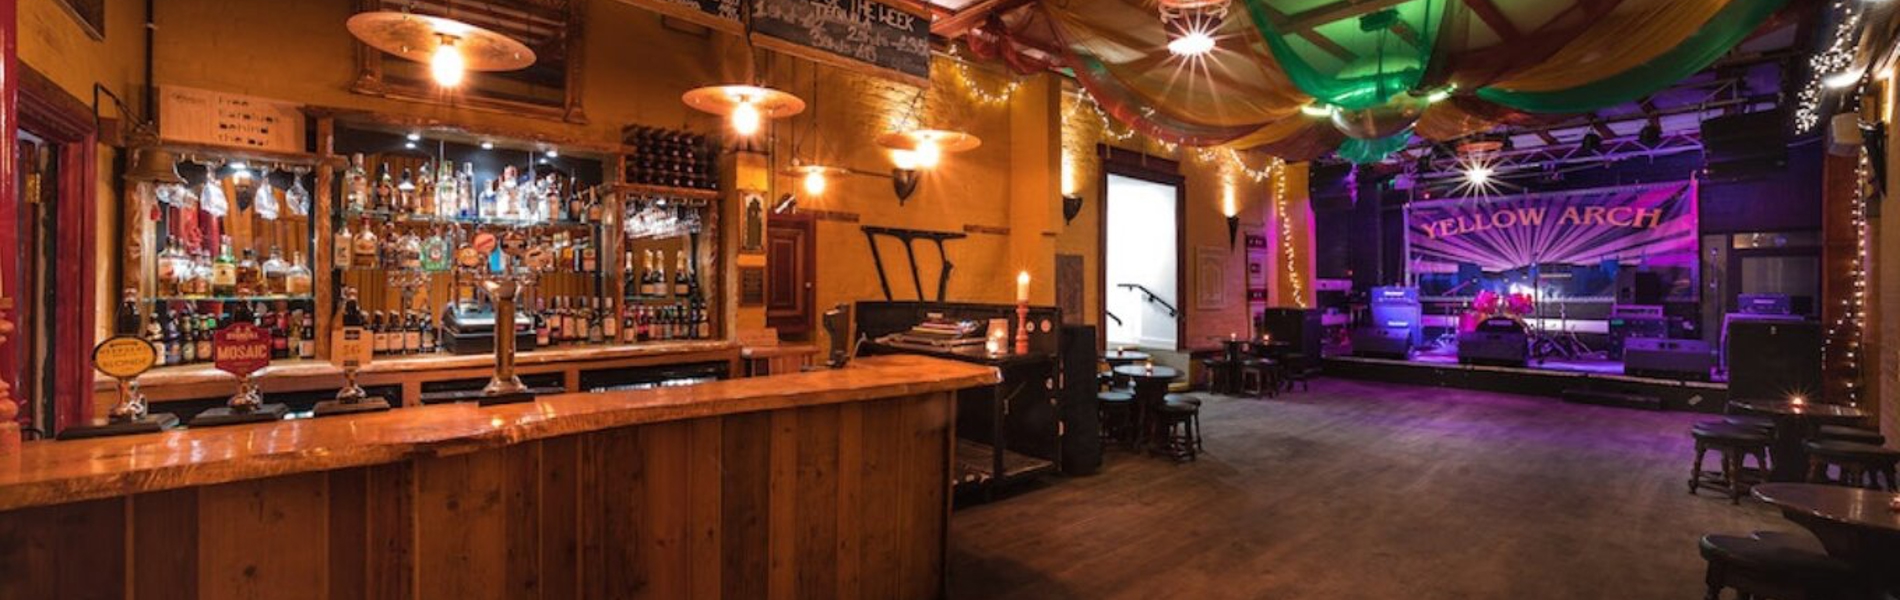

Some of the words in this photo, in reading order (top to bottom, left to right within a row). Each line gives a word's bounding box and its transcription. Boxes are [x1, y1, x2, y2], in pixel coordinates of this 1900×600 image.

[879, 4, 914, 32] WEEK
[219, 121, 269, 134] behind
[219, 133, 242, 142] the
[1421, 207, 1547, 239] YELLOW
[1557, 206, 1663, 230] ARCH
[216, 344, 267, 360] MOSAIC
